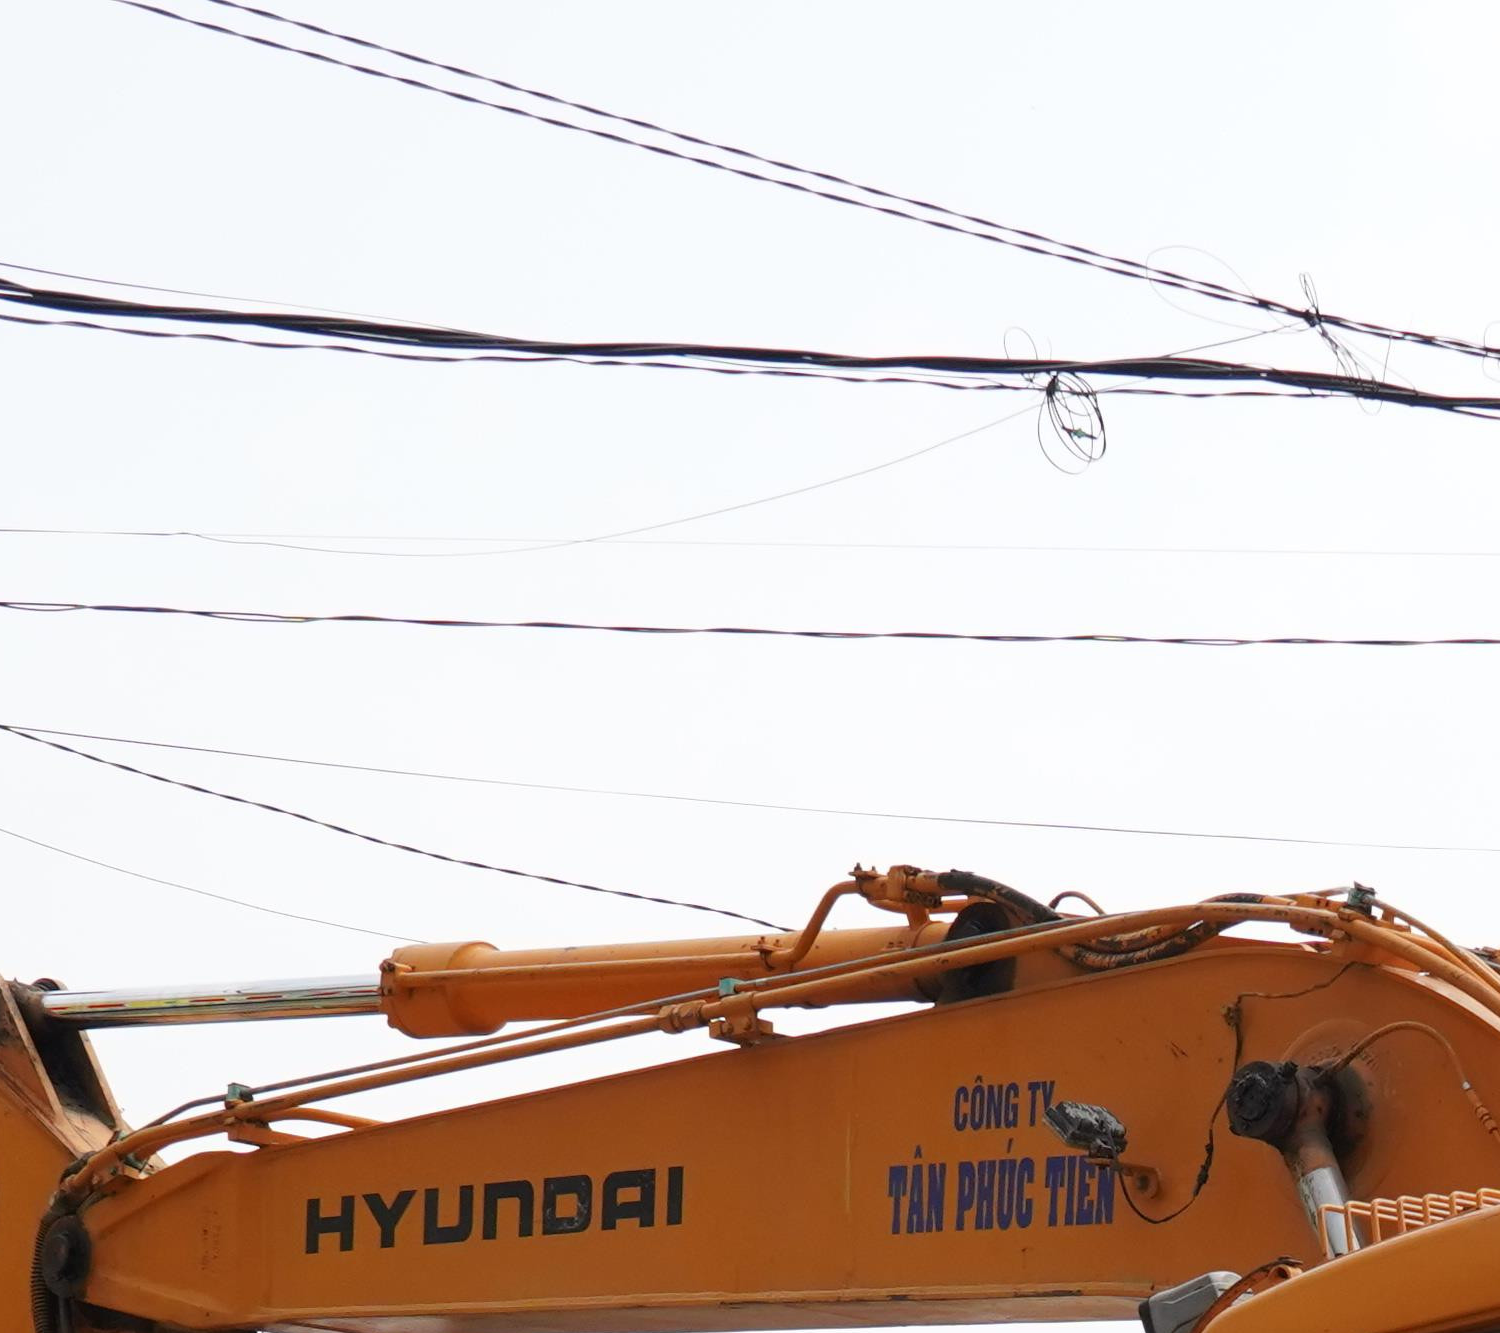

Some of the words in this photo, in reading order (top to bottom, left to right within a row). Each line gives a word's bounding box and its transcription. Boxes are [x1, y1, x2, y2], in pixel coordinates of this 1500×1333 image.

[953, 1075, 1020, 1132] CÔNG
[1028, 1080, 1056, 1127] TY
[304, 1166, 684, 1255] HYUNDAI
[888, 1145, 947, 1235] TÂN
[955, 1137, 1036, 1232] PHÚC
